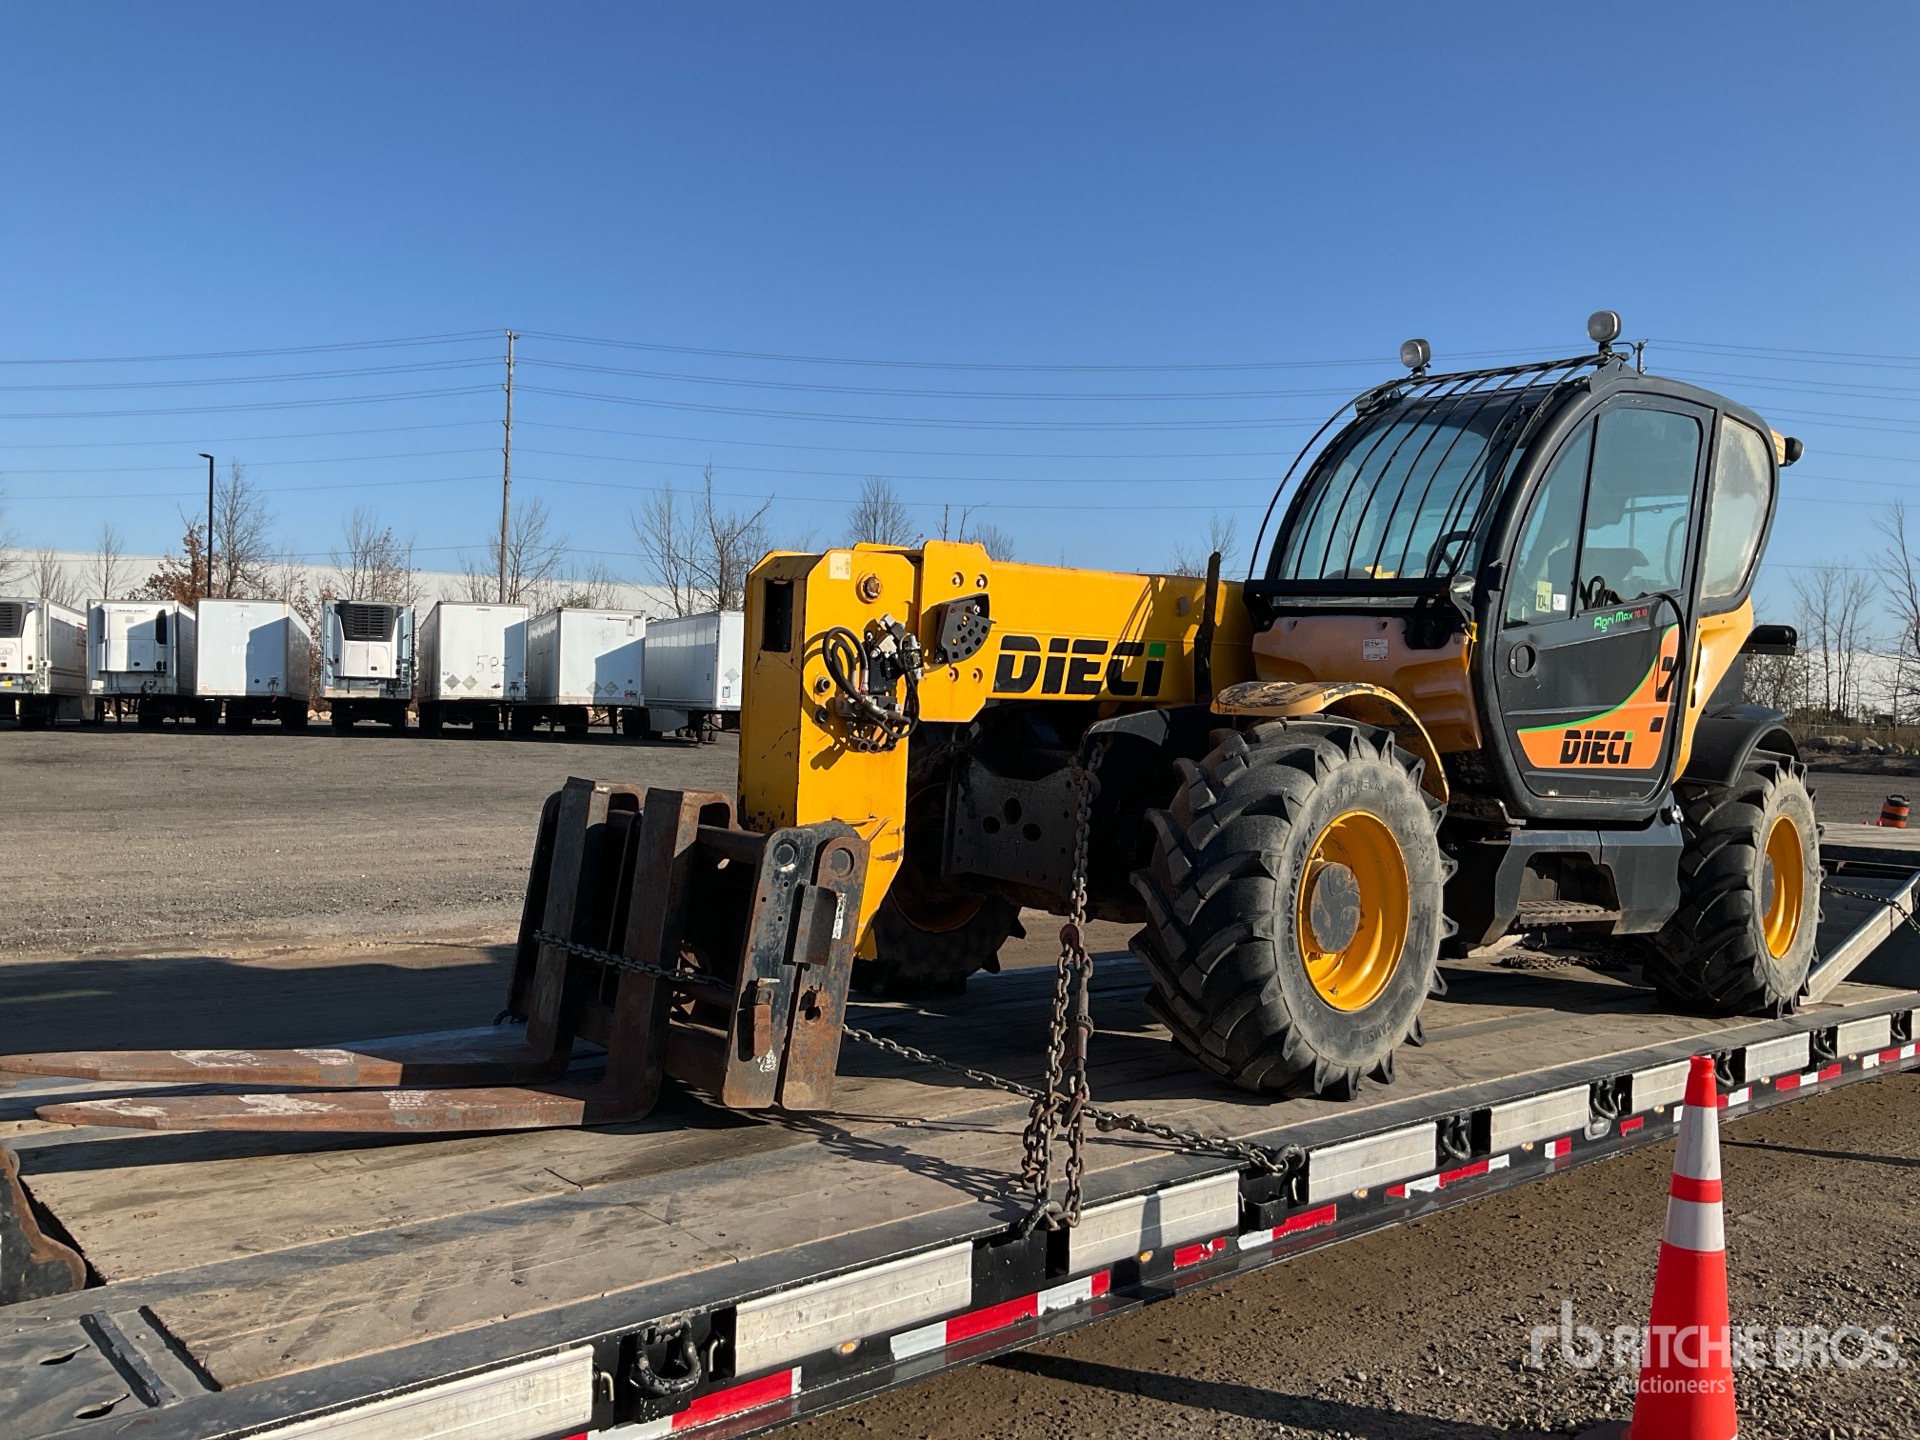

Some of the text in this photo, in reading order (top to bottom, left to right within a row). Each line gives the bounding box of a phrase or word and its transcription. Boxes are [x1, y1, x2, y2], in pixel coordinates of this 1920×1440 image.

[1594, 615, 1614, 633] Agri
[993, 635, 1167, 697] DIECI
[1559, 729, 1635, 764] DIECI
